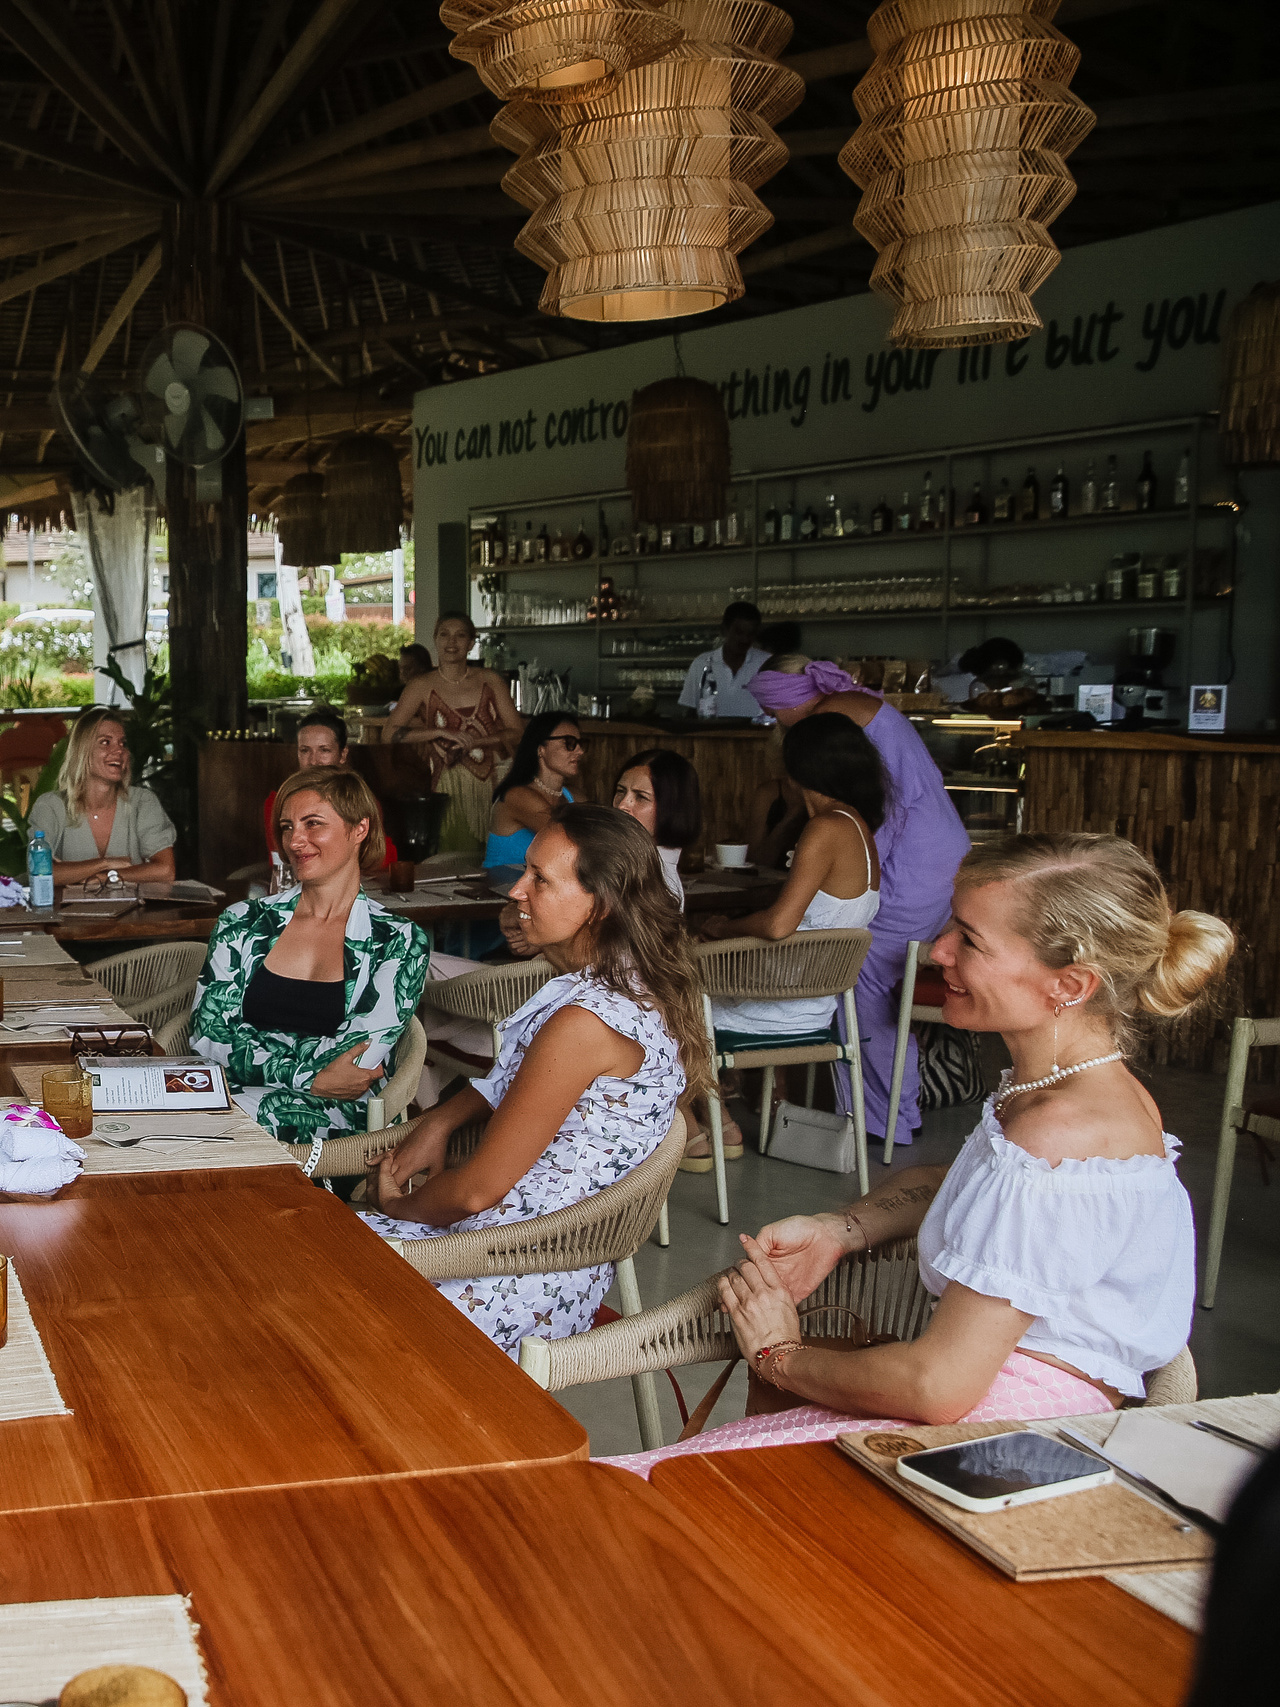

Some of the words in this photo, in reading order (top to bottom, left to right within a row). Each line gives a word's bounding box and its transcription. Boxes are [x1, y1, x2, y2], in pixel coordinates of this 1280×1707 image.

[415, 424, 448, 469] You
[454, 422, 492, 462] can
[497, 408, 537, 456] not
[545, 398, 629, 449] contro
[821, 352, 852, 405] in
[861, 349, 942, 413] your
[1044, 302, 1124, 370] but
[1135, 289, 1226, 372] you
